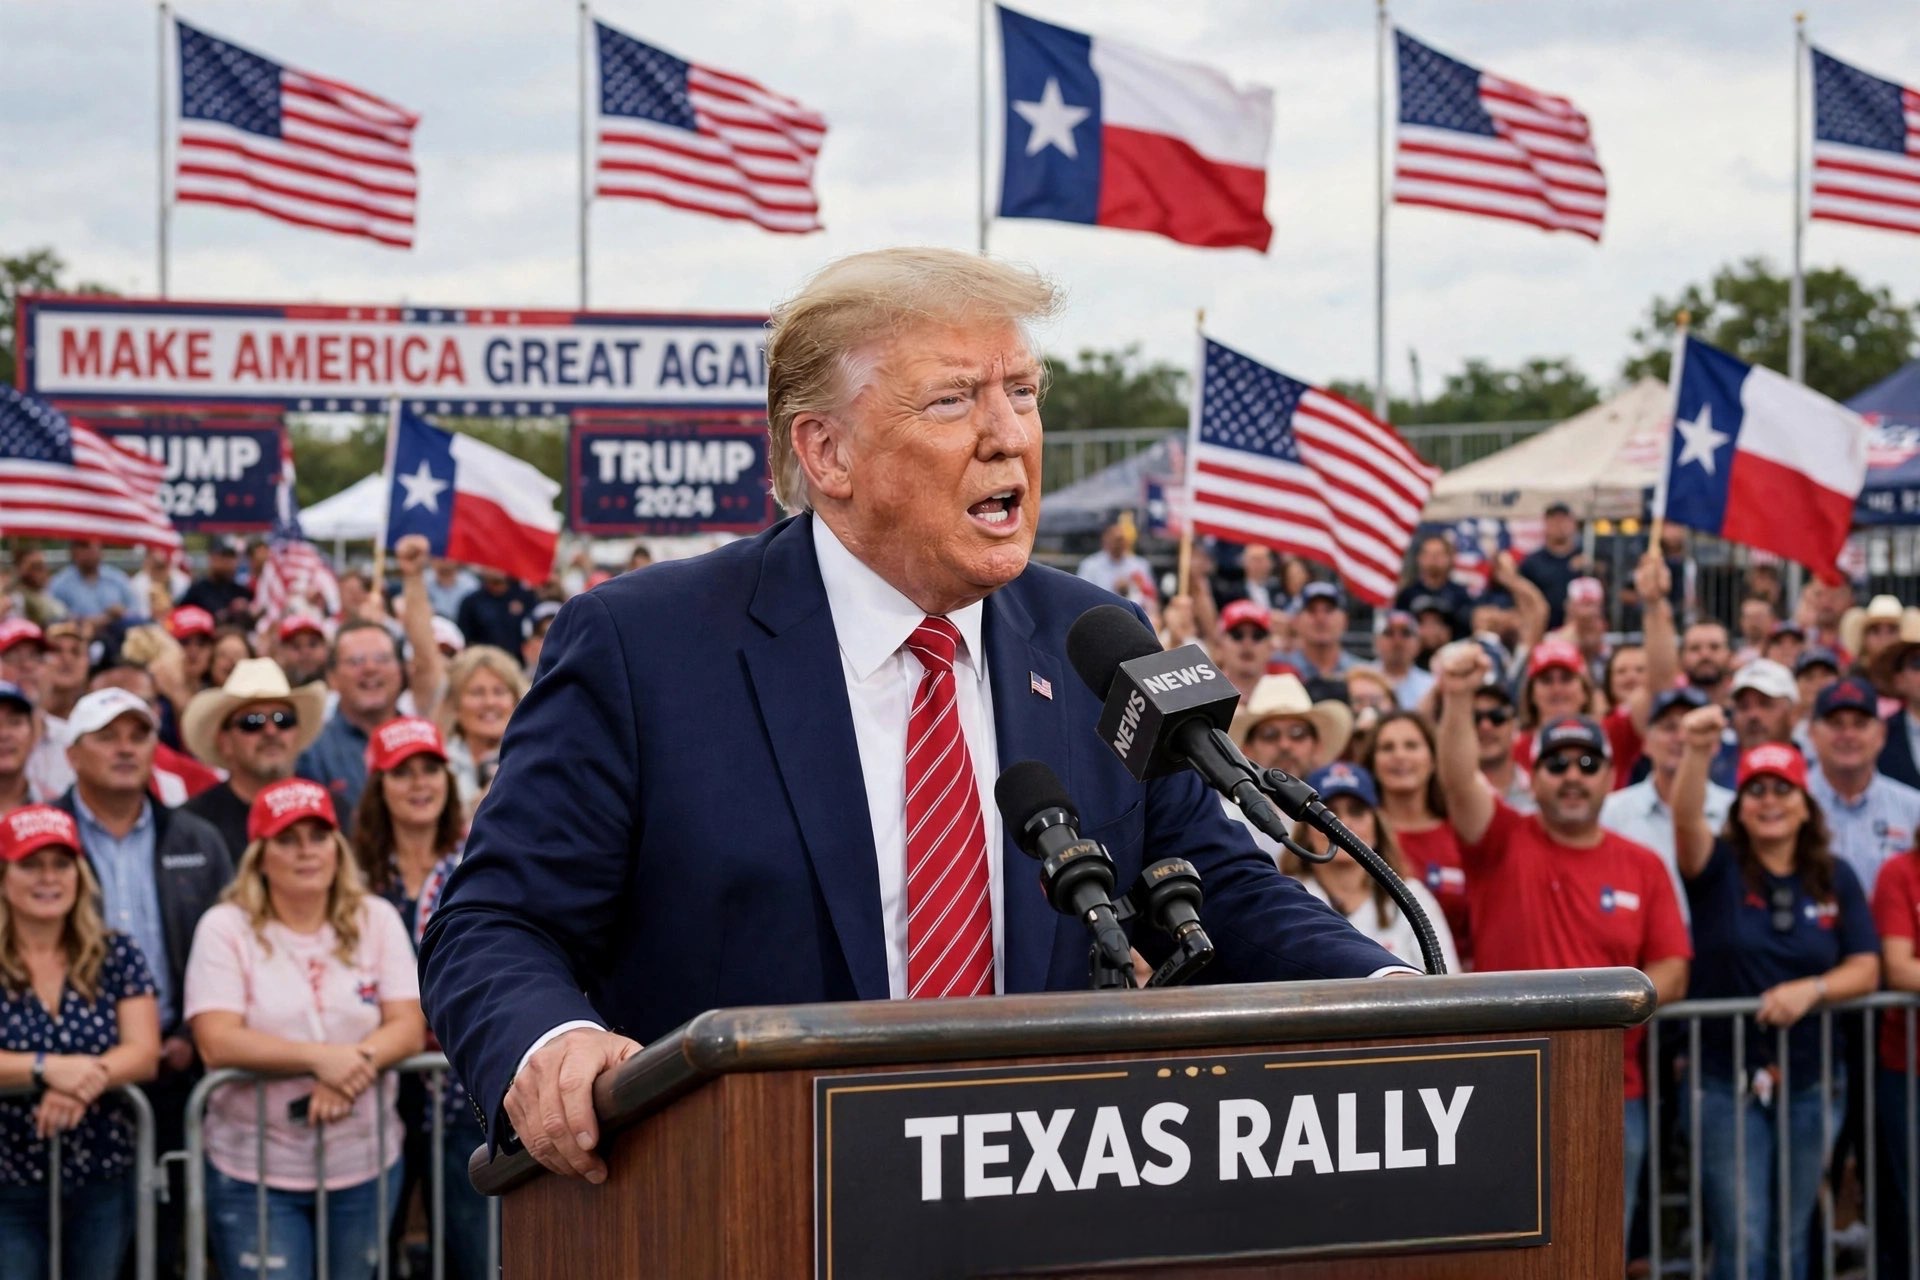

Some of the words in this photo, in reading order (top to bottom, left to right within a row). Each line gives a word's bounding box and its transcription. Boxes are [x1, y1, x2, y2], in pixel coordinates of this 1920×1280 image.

[60, 328, 213, 380] MAKE
[232, 332, 466, 386] AMERICA
[484, 338, 641, 388] GREAT
[657, 340, 767, 388] AGAI
[112, 434, 262, 482] UMP
[590, 439, 756, 485] TRUMP
[158, 482, 218, 517] 024
[633, 484, 716, 518] 2024
[1143, 663, 1216, 694] NEWS
[1113, 689, 1146, 759] NEWS
[1058, 843, 1095, 862] NEW
[1152, 863, 1189, 879] NEW
[904, 1101, 1192, 1201] TEXAS
[1219, 1085, 1474, 1181] RALLY
